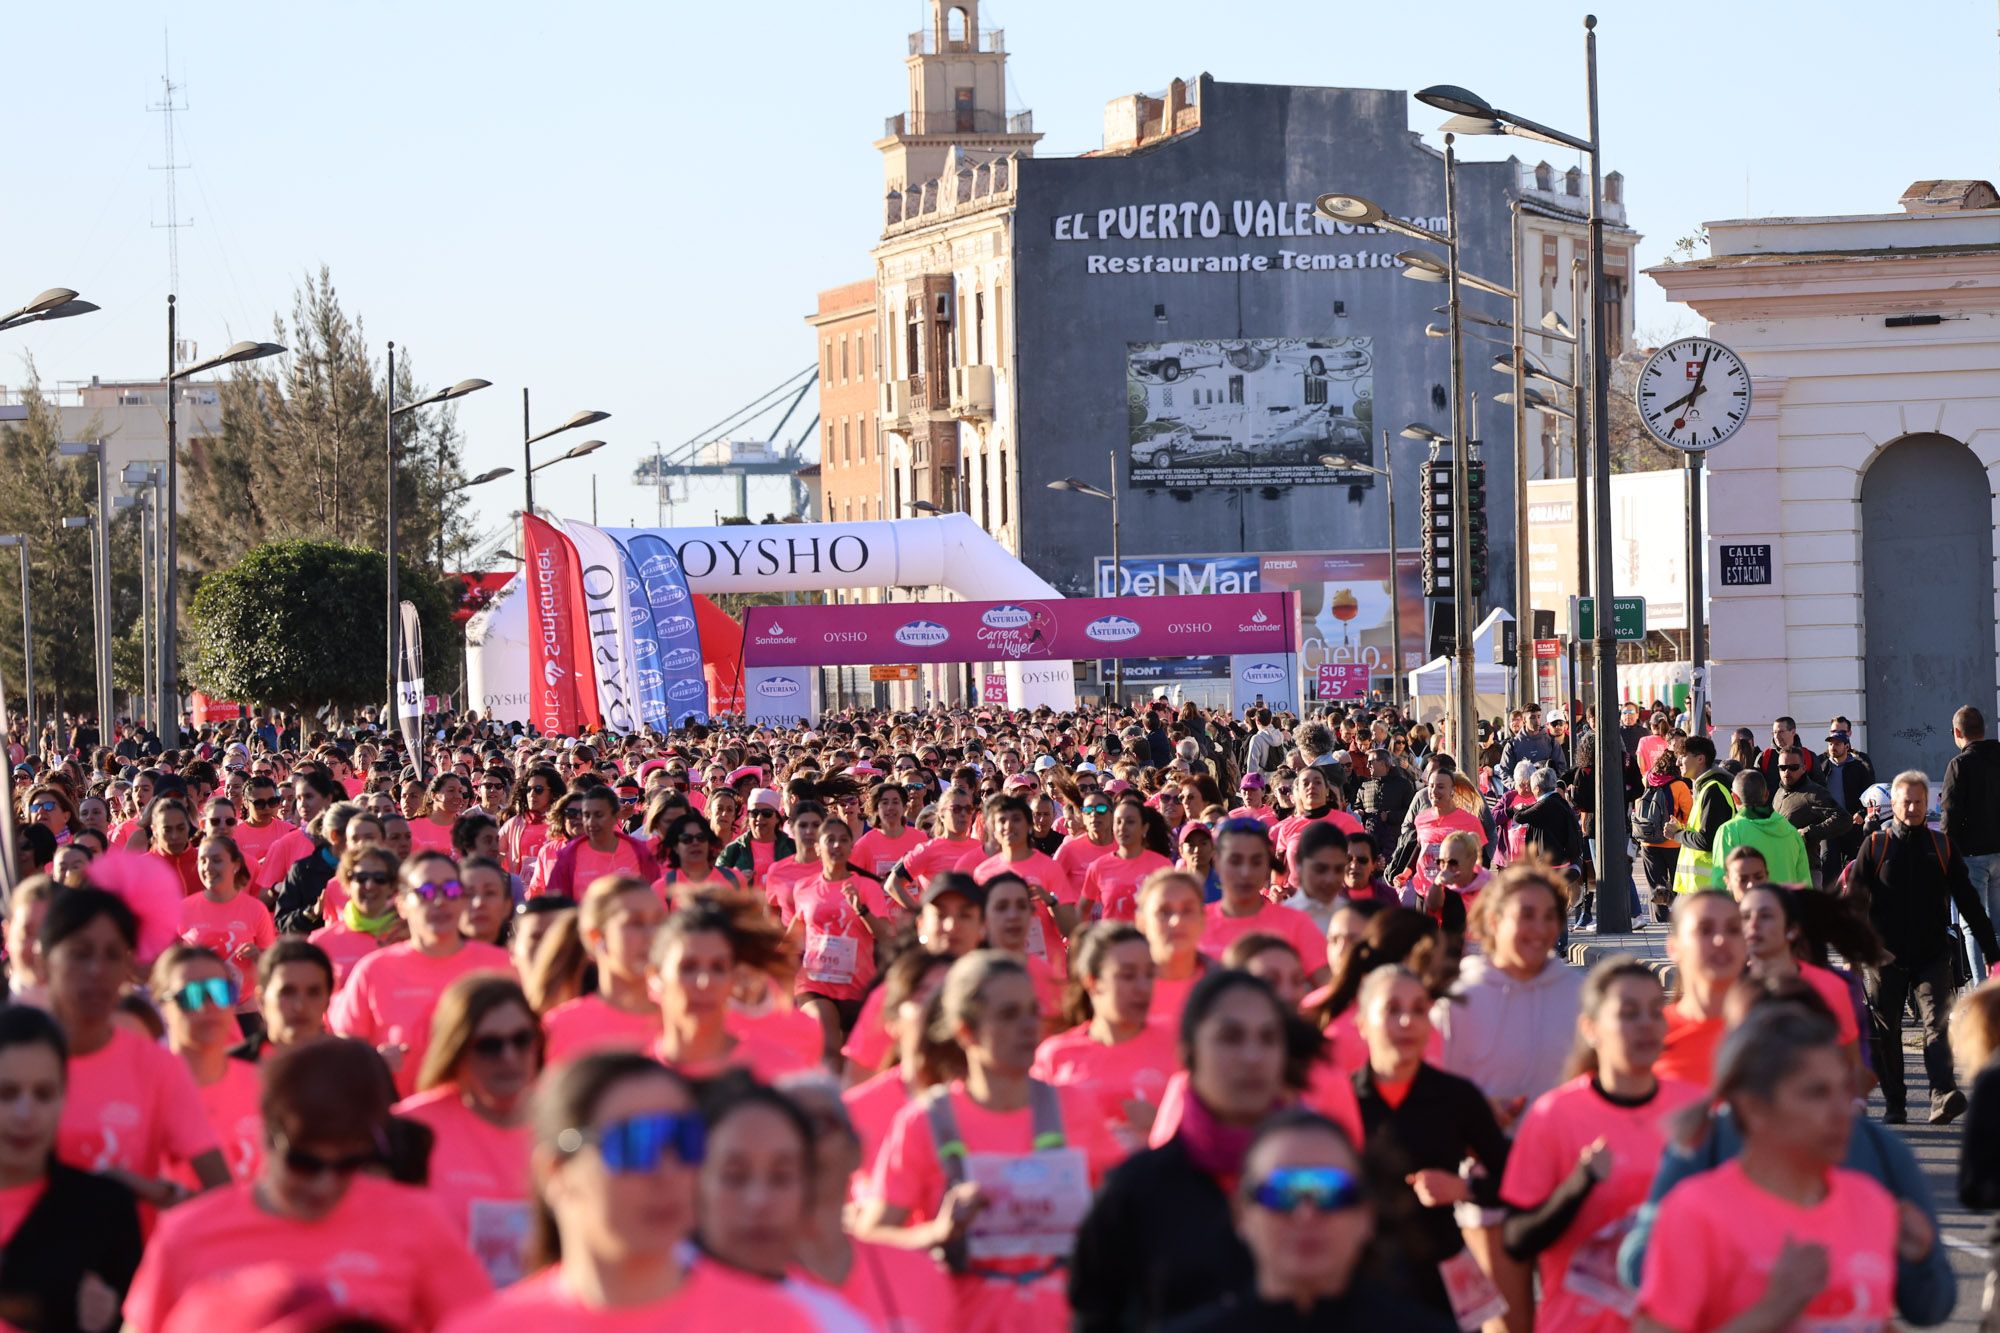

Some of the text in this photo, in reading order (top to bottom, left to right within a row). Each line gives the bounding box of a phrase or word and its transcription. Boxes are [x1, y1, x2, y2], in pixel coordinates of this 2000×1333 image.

[1055, 213, 1089, 240] EL
[1098, 200, 1221, 240] PUERTO
[1088, 253, 1268, 274] Restaurante
[678, 534, 870, 578] OYSHO
[1728, 547, 1765, 557] CALLE
[1734, 556, 1757, 566] DE LA
[1101, 562, 1257, 598] Del Mar
[1726, 565, 1766, 584] ESTACION
[1613, 602, 1636, 610] GUDA
[985, 613, 1029, 623] ASTURIANA
[1089, 625, 1137, 636] ASTURIANA
[1168, 623, 1212, 634] OYSHO
[1238, 623, 1281, 632] Santander
[1614, 627, 1635, 637] NÇA
[823, 631, 868, 642] OYSHO
[900, 630, 946, 640] ASTURIANA
[977, 628, 1019, 640] Carrera
[755, 635, 797, 645] Santander
[1002, 638, 1035, 658] Mujer
[1245, 671, 1283, 680] ASTURIANA
[1321, 666, 1346, 677] SUB
[986, 675, 1007, 685] SUB
[1022, 670, 1070, 685] OYSHO
[760, 684, 797, 693] ASTURIANA
[1242, 701, 1288, 712] OYHO
[755, 713, 801, 725] OYSHO
